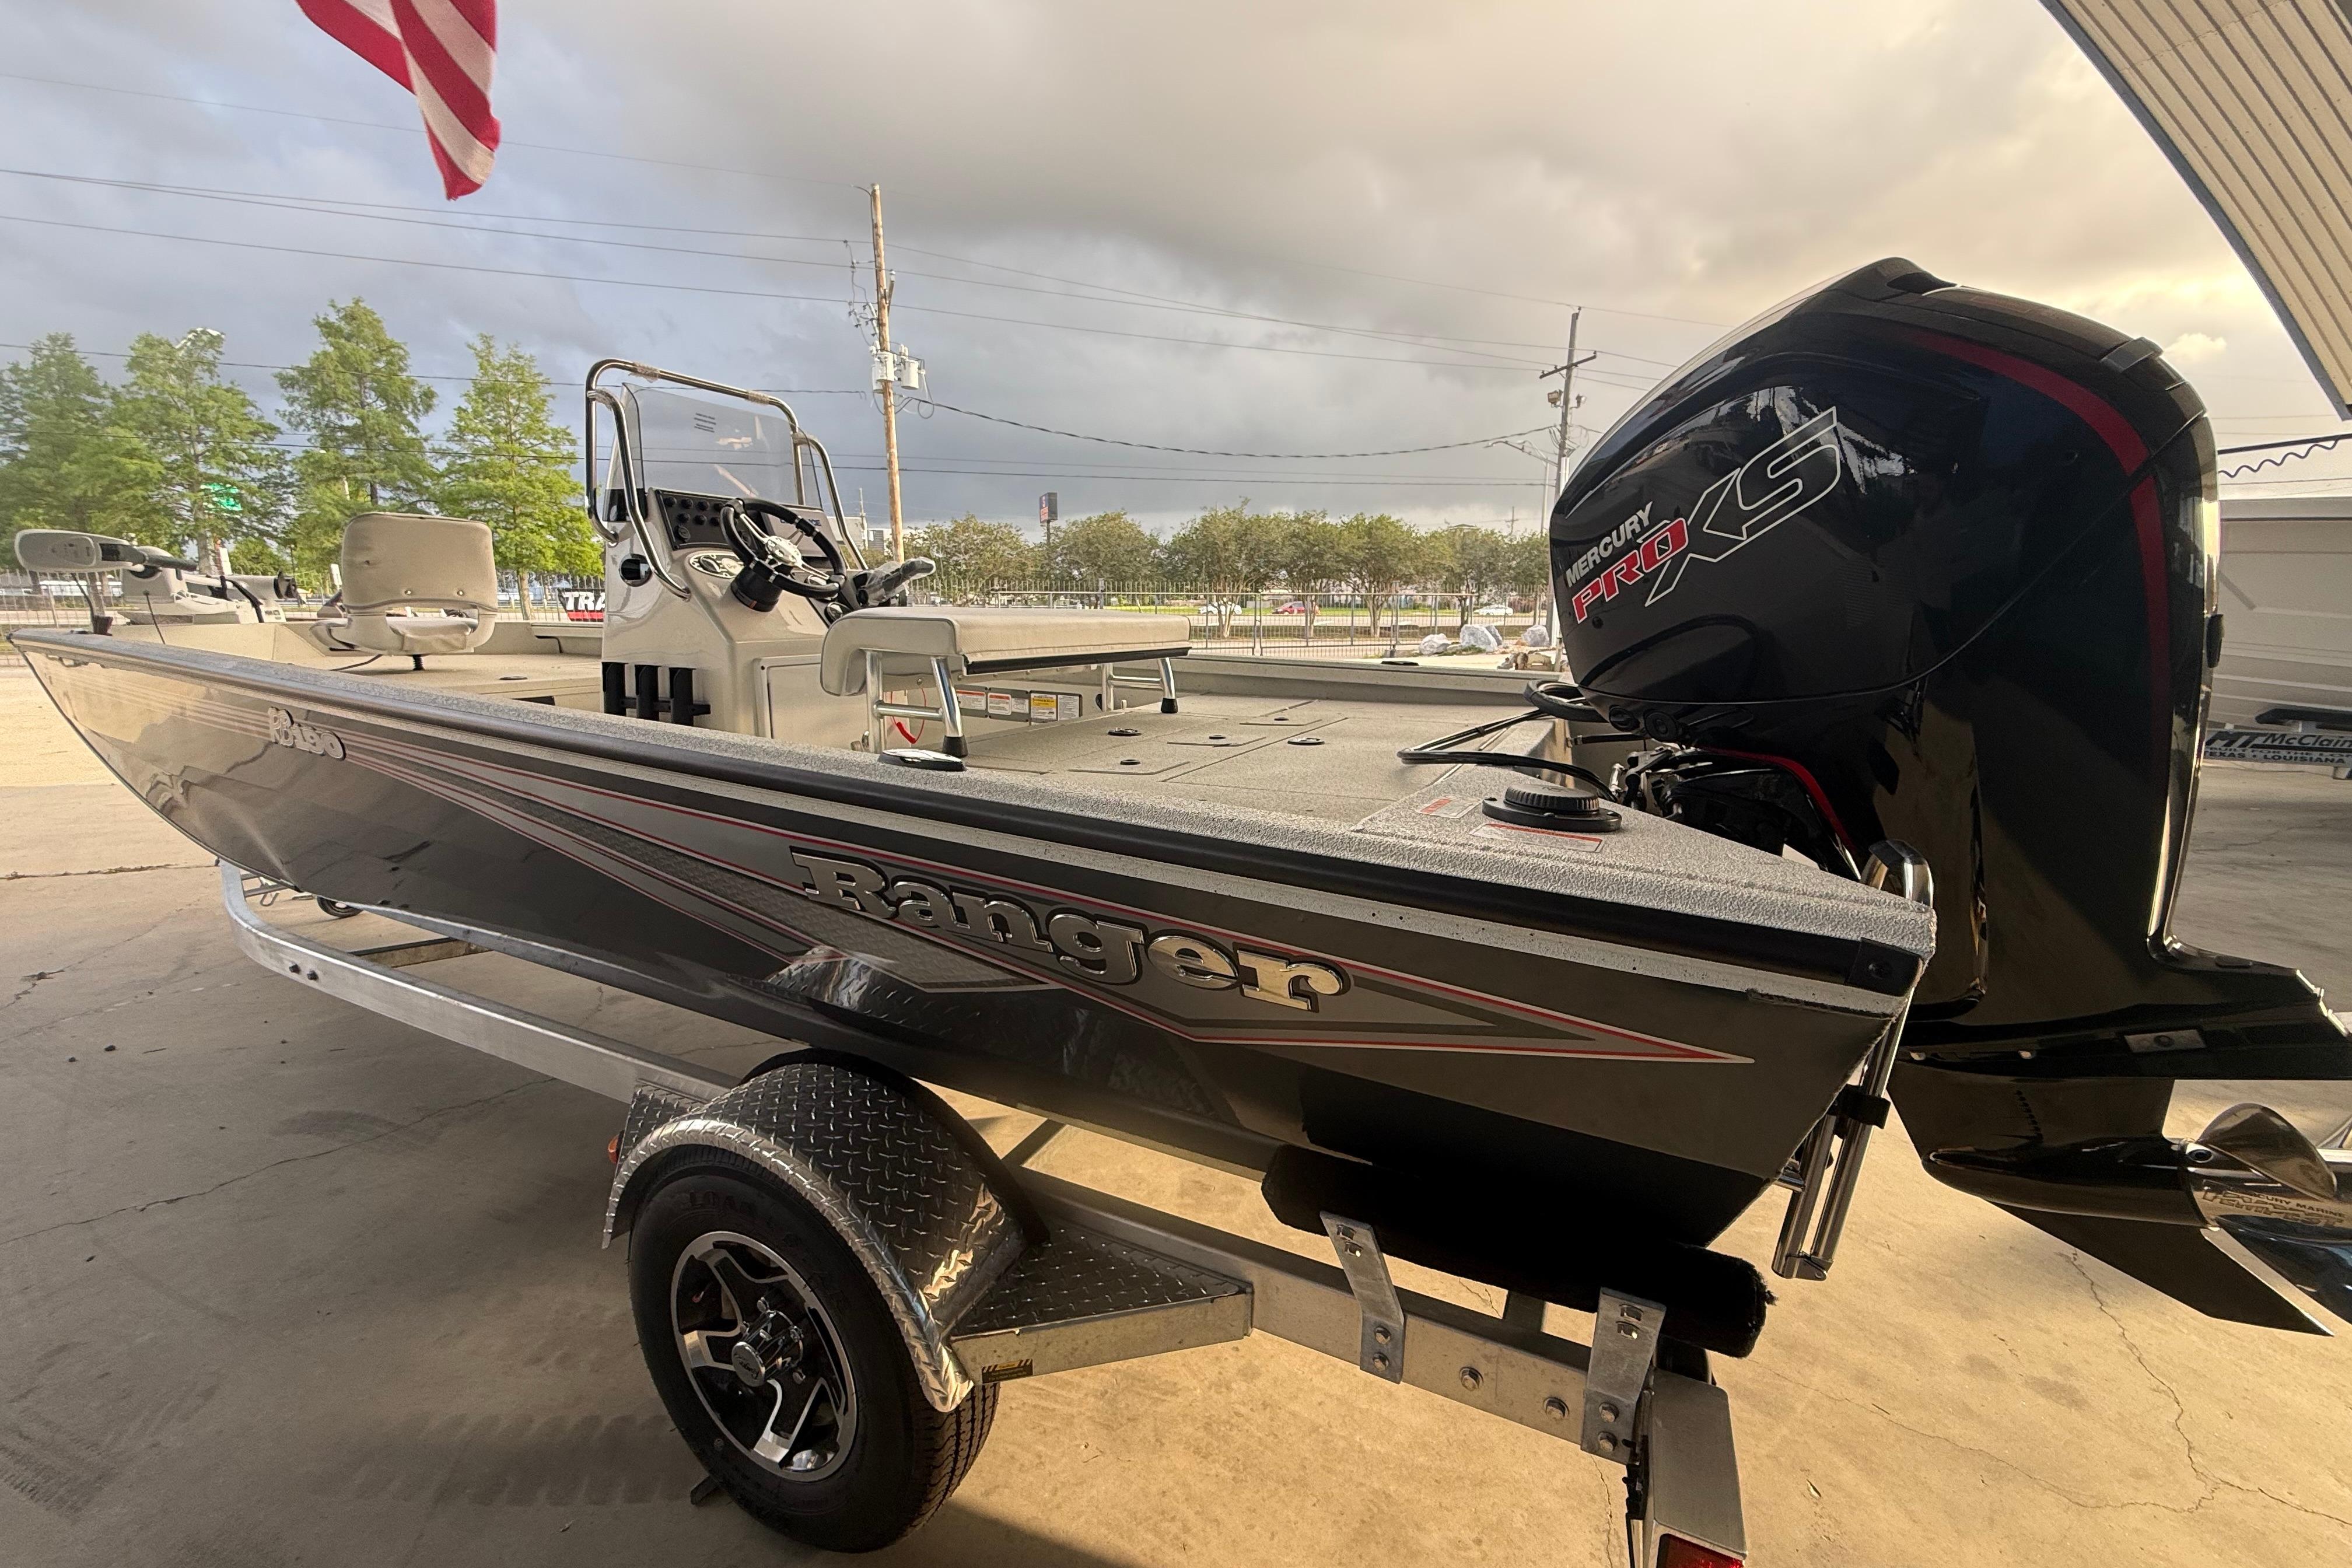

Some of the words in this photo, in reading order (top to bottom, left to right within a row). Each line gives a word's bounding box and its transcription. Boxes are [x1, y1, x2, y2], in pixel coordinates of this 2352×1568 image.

[1572, 517, 1689, 625] PRO
[1636, 405, 1842, 607] XS
[1566, 501, 1653, 587] MERCURY
[2205, 730, 2266, 748] MT
[2263, 754, 2346, 764] LOUISIANA
[790, 848, 1346, 1012] Ranger
[2296, 1202, 2346, 1219] MARINE
